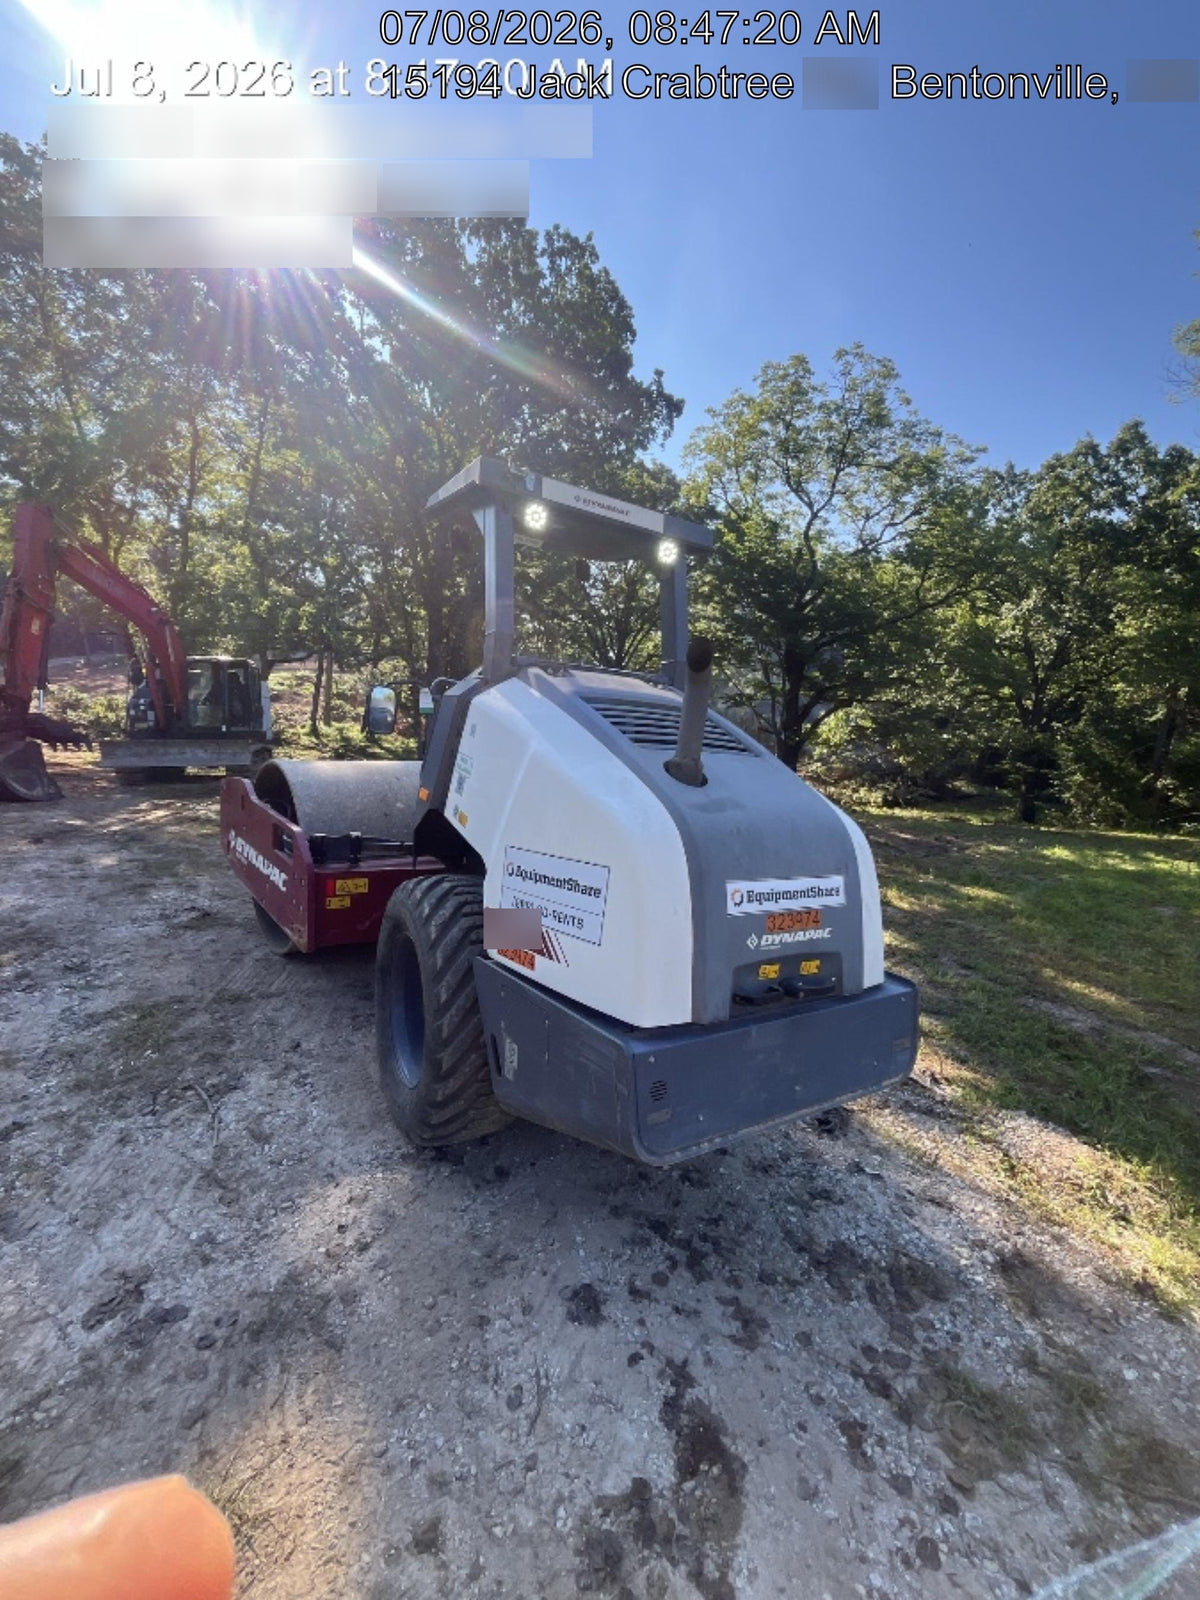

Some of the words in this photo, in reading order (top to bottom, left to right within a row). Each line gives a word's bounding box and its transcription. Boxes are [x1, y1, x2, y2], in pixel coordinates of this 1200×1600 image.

[515, 865, 602, 899] EquipmentShare
[746, 885, 841, 905] EquipmentShare
[760, 927, 832, 946] DYNAPAC
